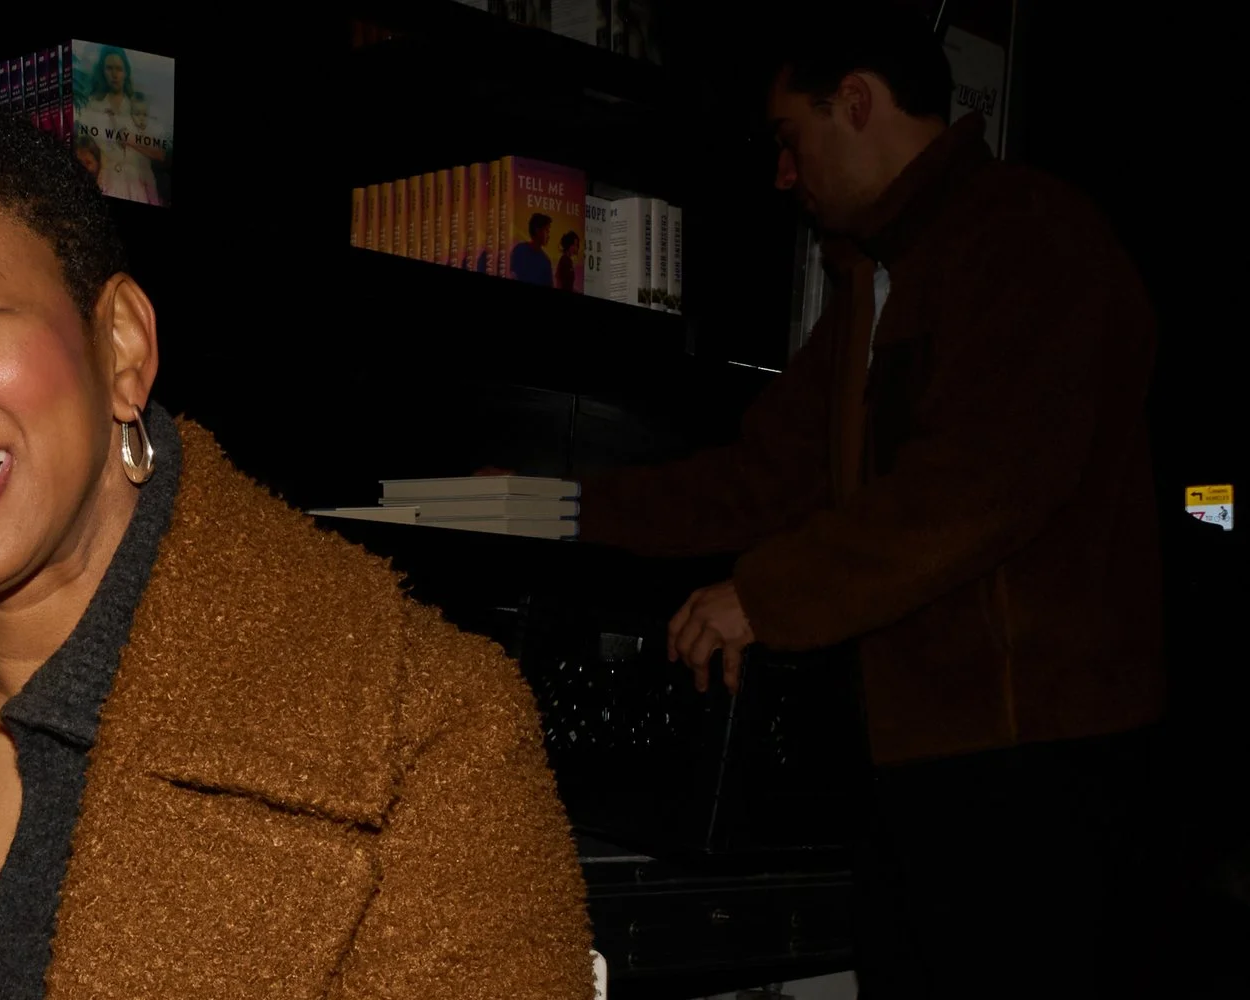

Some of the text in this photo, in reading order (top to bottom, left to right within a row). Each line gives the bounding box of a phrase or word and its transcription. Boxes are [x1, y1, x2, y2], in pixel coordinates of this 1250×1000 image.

[81, 126, 168, 149] NO WAY HOME
[518, 174, 544, 192] TELL
[546, 181, 565, 196] ME
[526, 194, 581, 217] EVERY LIE
[586, 204, 606, 222] HOPE
